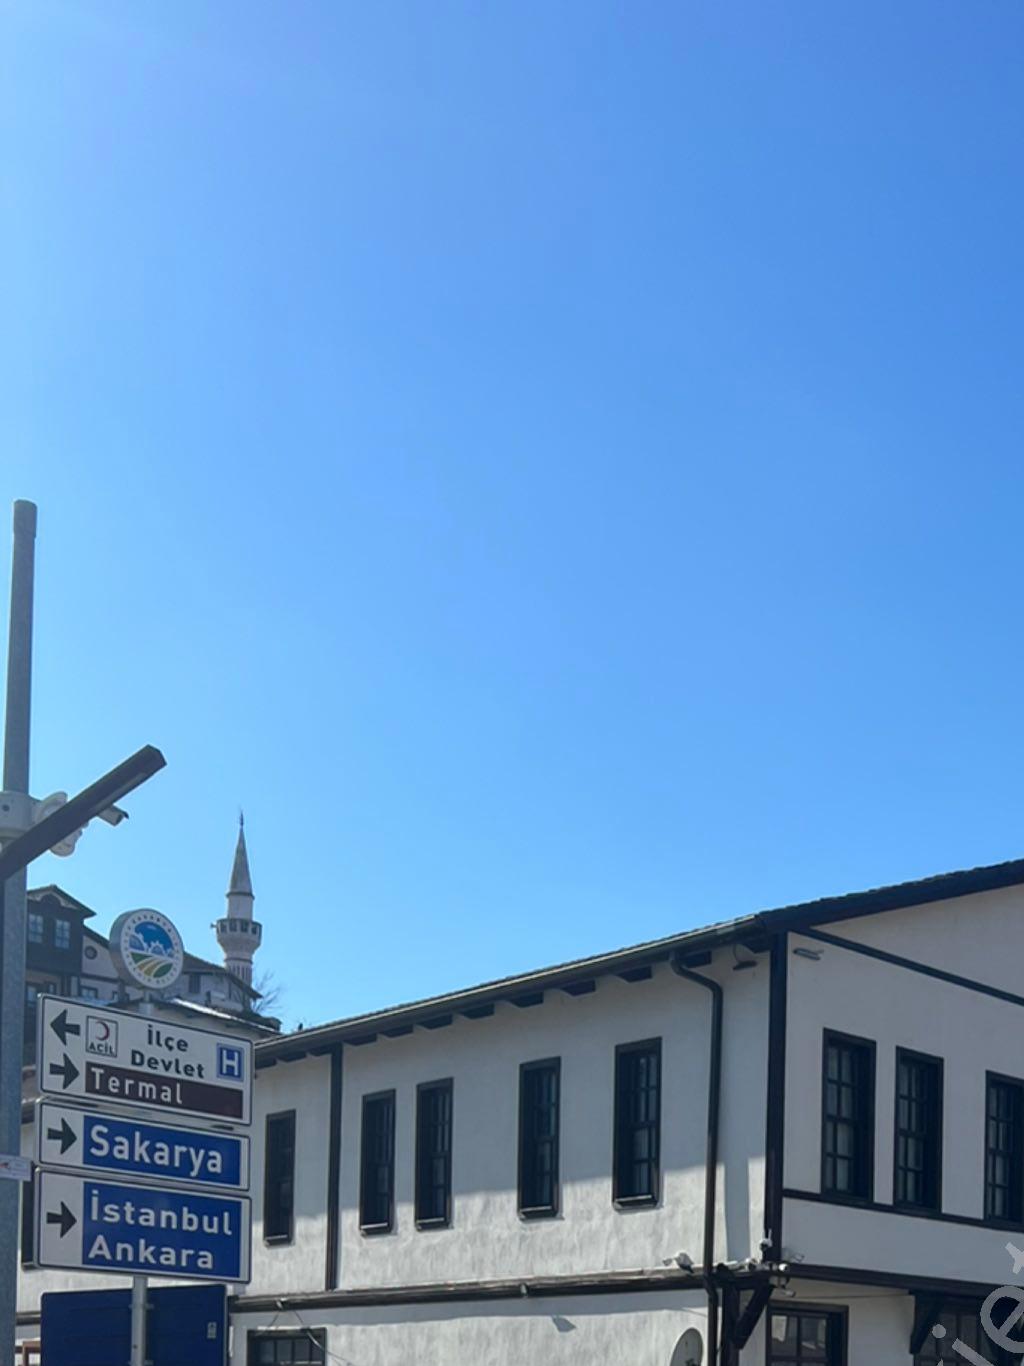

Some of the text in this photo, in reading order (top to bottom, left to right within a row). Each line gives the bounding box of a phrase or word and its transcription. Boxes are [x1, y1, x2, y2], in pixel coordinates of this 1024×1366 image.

[147, 1024, 189, 1051] İlçe
[131, 1049, 205, 1079] Devlet
[222, 1049, 240, 1076] H
[91, 1067, 183, 1104] Termal
[89, 1125, 224, 1177] Sakarya
[90, 1190, 233, 1236] İstanbul
[88, 1235, 214, 1271] Ankara
